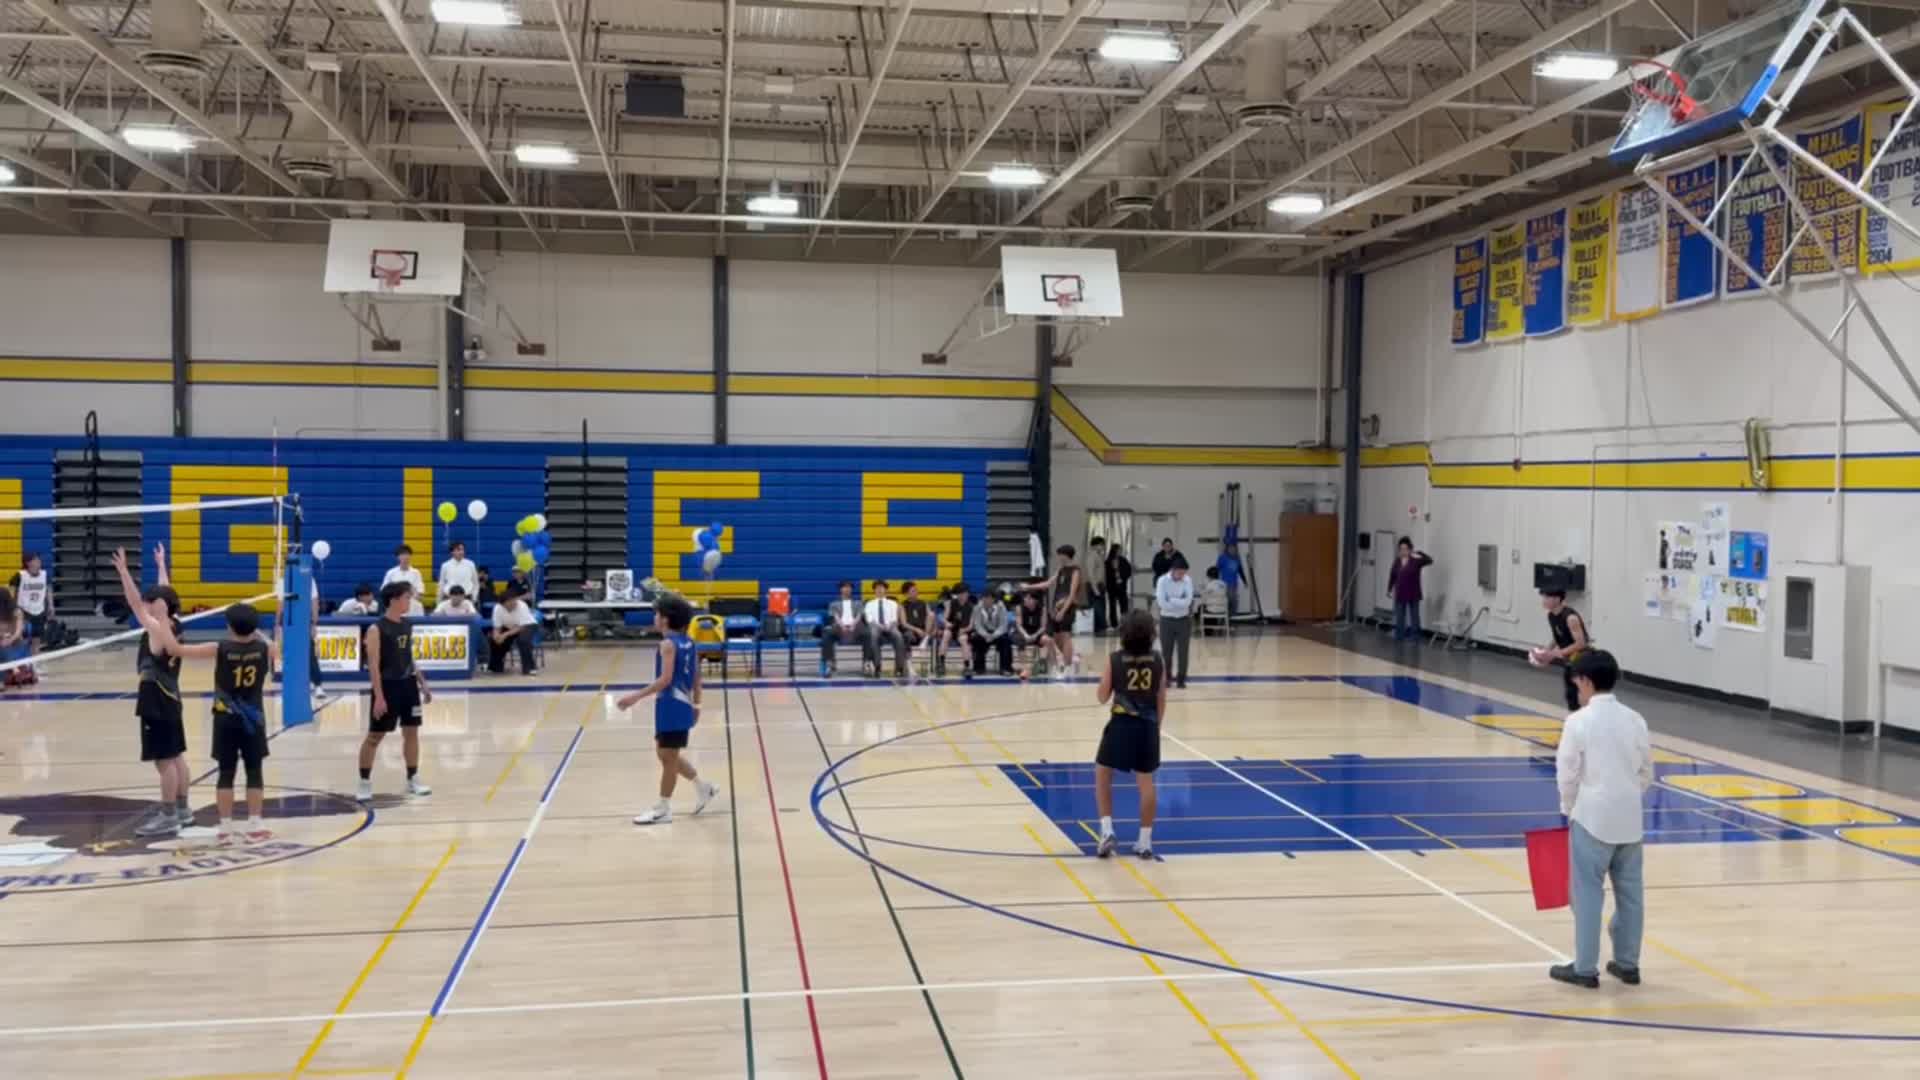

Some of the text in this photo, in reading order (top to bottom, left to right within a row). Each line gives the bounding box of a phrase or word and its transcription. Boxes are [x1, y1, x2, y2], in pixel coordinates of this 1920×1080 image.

[412, 635, 466, 661] EAGLES
[231, 665, 258, 689] 13
[1127, 668, 1153, 691] 23
